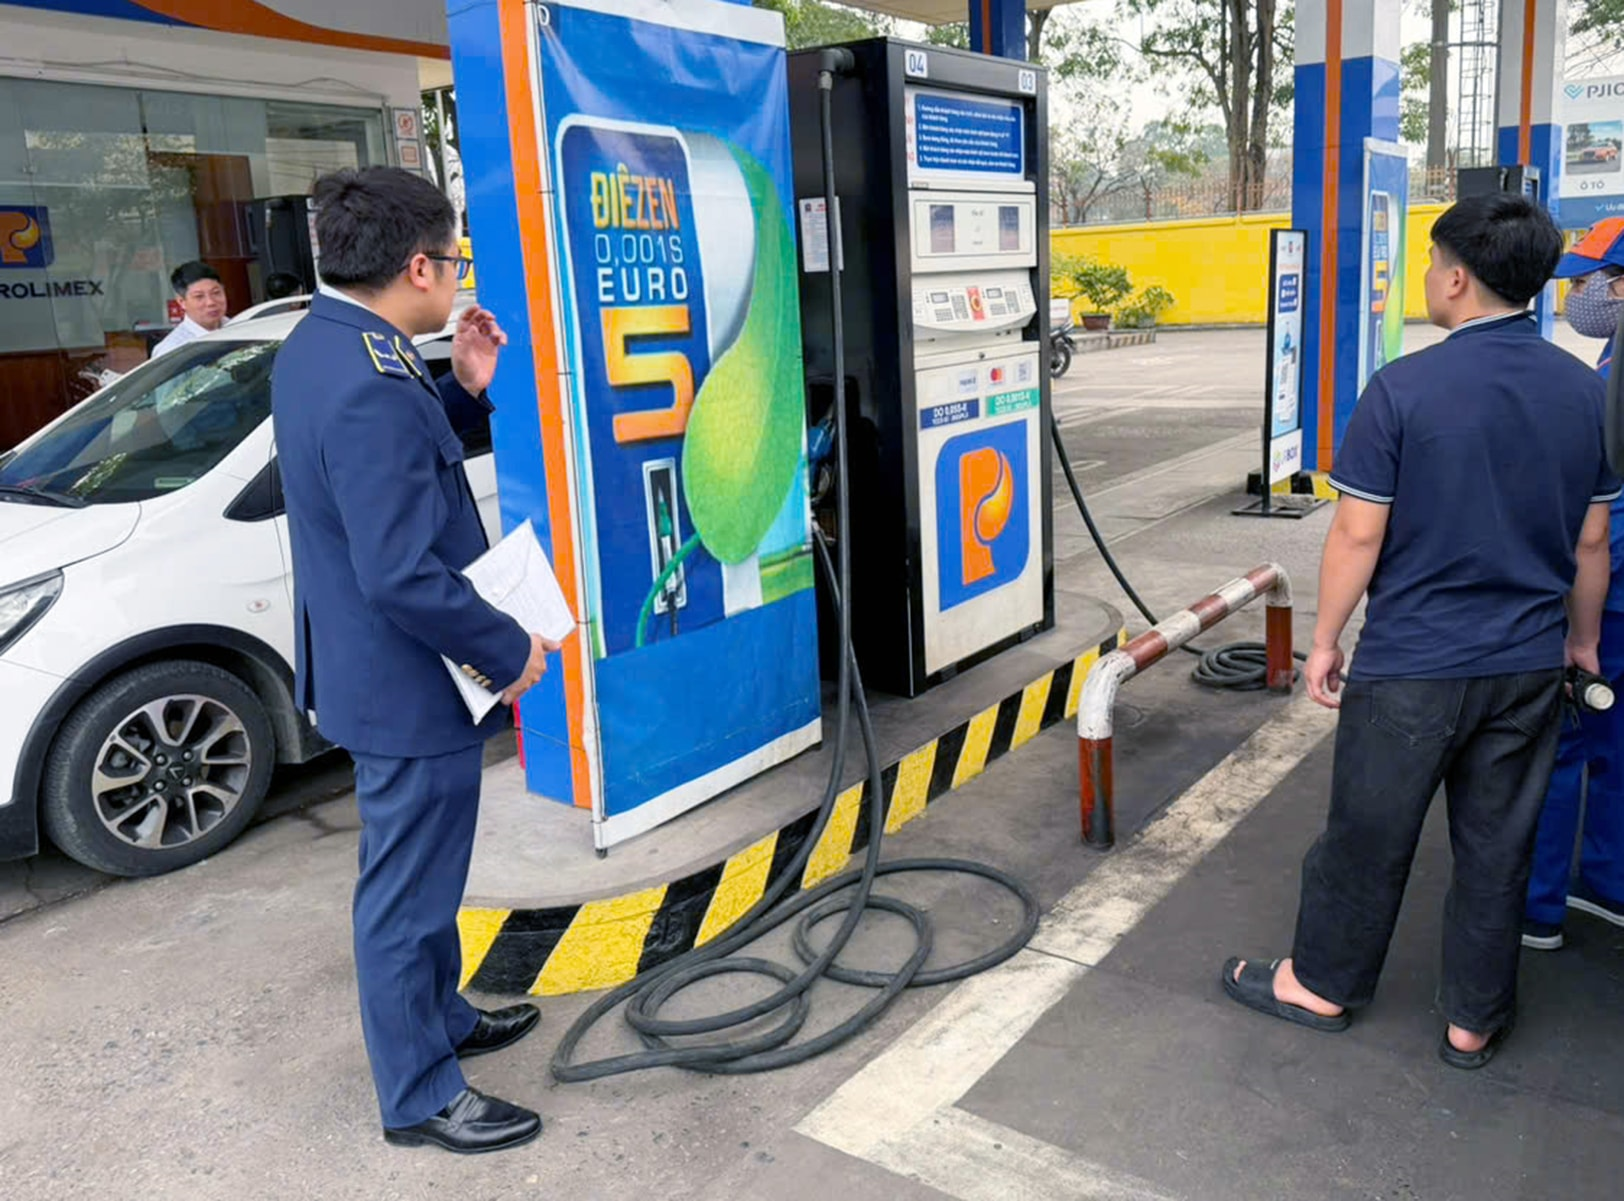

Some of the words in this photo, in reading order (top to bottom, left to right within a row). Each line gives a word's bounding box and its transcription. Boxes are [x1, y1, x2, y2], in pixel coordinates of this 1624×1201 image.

[909, 53, 925, 73] 04
[1021, 72, 1034, 91] 03
[590, 162, 680, 230] ĐIÊZEN
[595, 234, 684, 267] 0,001S
[0, 280, 104, 299] ROLIMEX
[597, 267, 688, 302] EURO
[600, 304, 694, 443] 5
